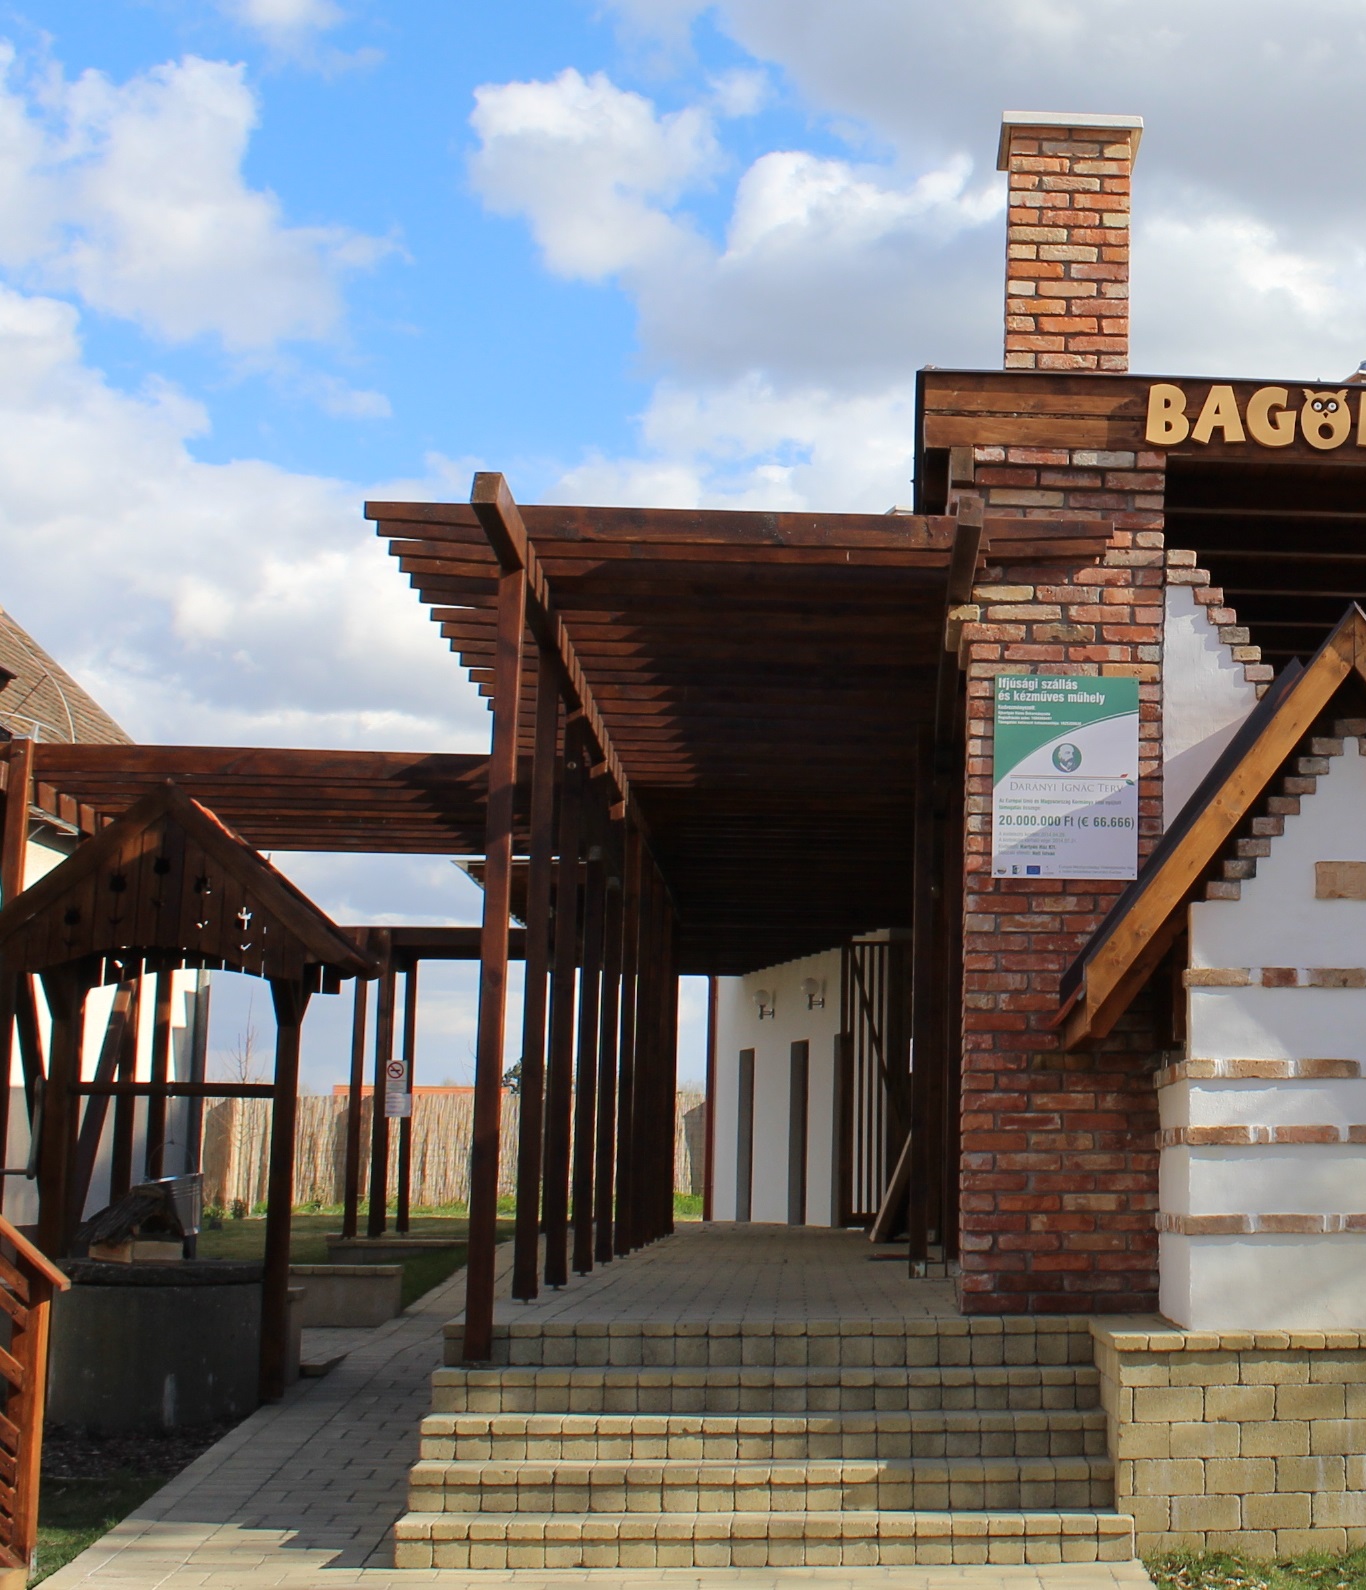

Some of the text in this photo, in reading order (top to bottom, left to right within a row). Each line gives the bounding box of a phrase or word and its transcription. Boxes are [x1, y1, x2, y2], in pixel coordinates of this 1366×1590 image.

[998, 677, 1078, 691] Ifjúsági szállás
[998, 689, 1106, 705] és kézműves műhely
[1098, 783, 1123, 793] TERV
[998, 815, 1061, 827] 20.000.000
[1063, 816, 1074, 827] Ft
